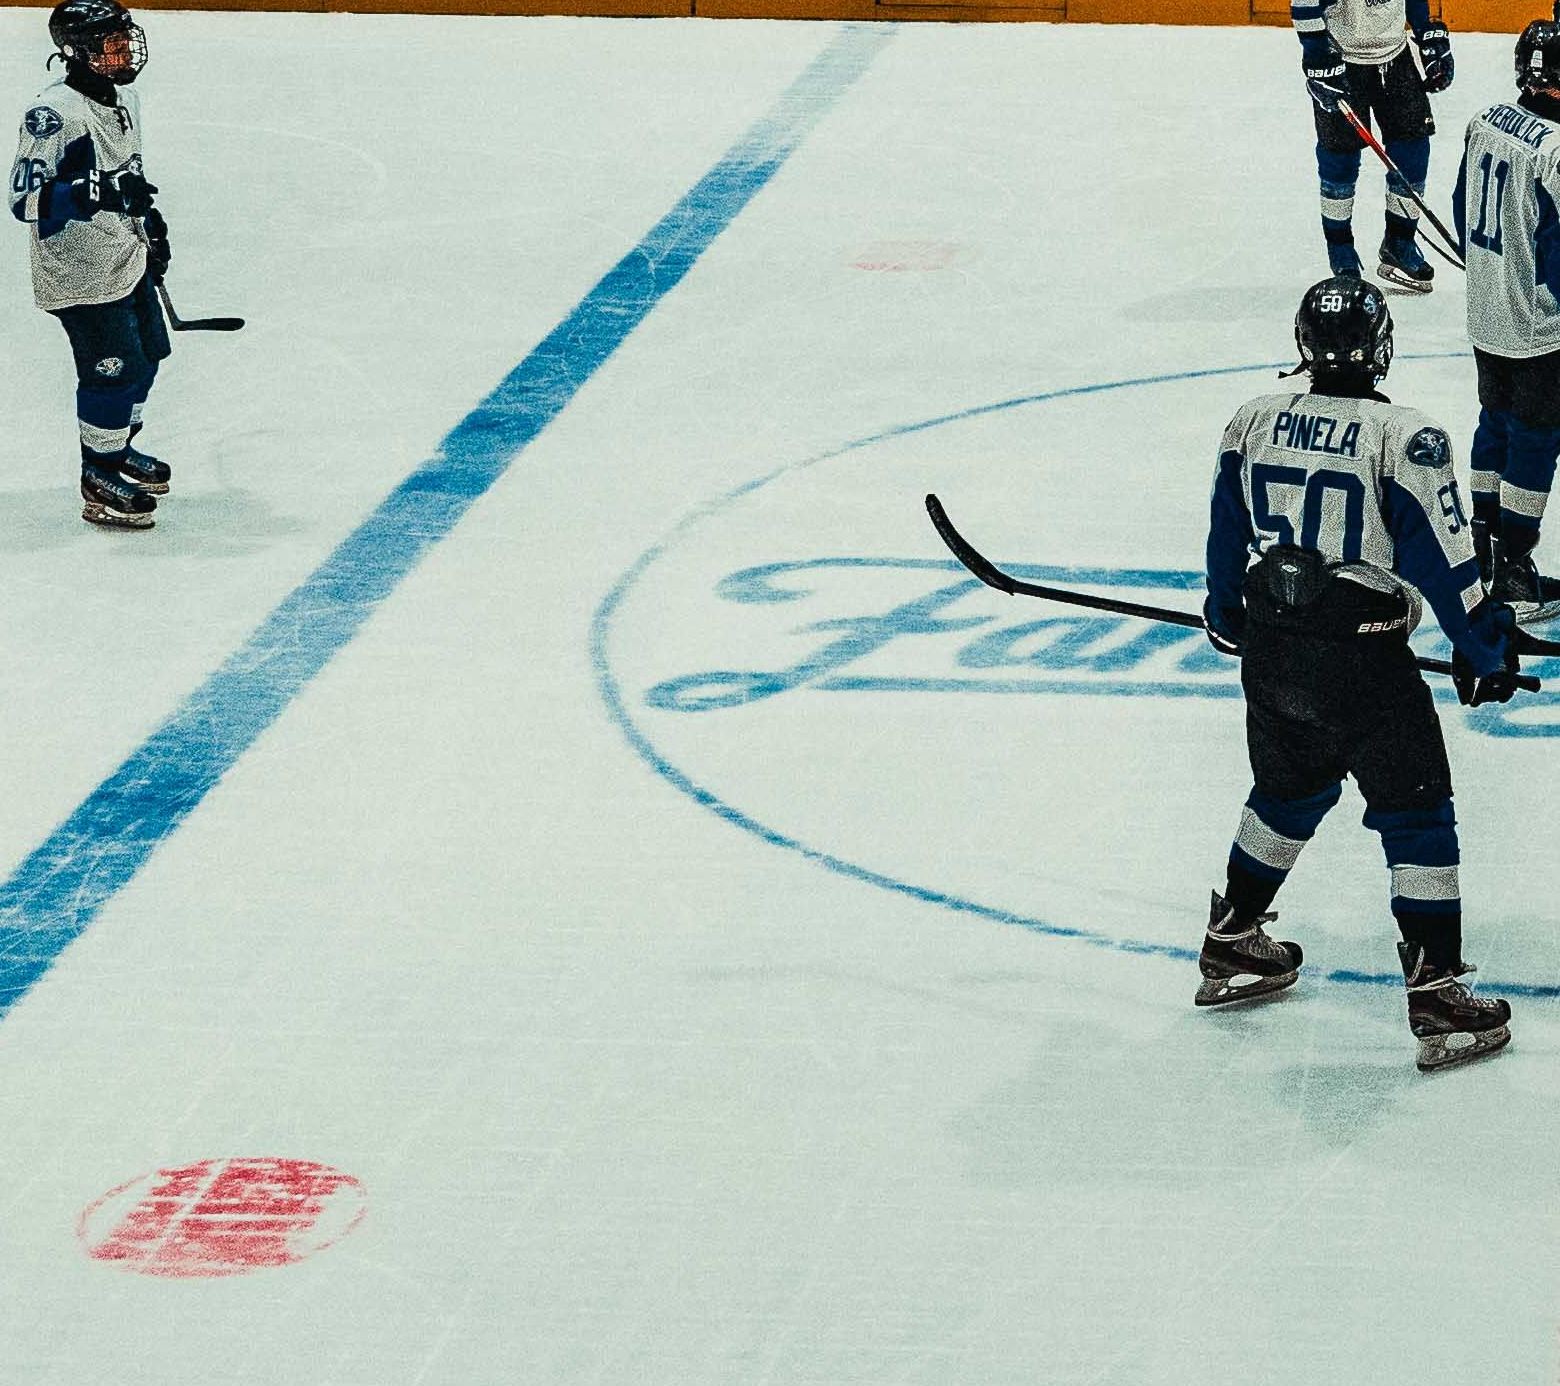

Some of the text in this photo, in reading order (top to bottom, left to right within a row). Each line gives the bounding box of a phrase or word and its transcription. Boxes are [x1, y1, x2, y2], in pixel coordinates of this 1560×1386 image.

[1469, 151, 1510, 257] 11
[1272, 410, 1363, 458] PINELA
[1250, 461, 1366, 566] 50
